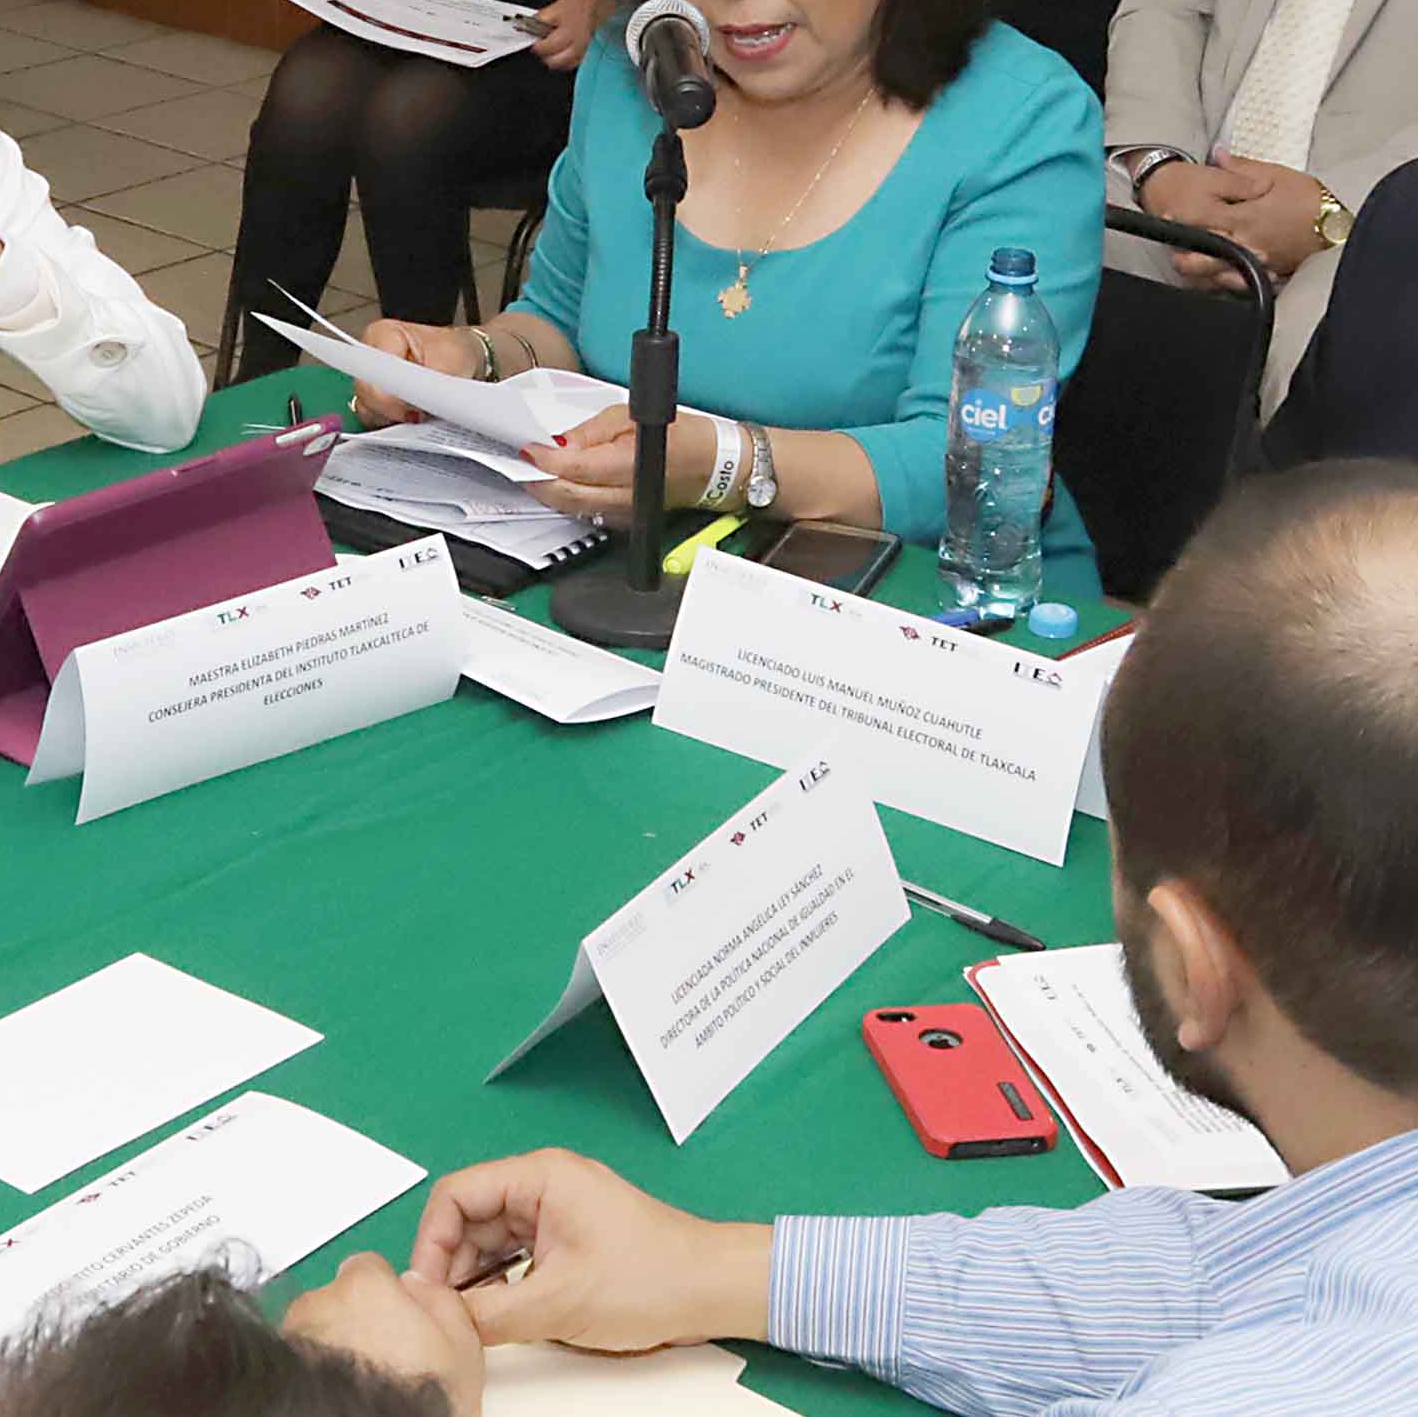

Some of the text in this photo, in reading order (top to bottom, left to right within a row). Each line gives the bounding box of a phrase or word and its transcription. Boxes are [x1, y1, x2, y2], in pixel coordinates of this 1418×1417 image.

[961, 398, 1009, 432] ciel
[217, 605, 250, 625] TLX
[810, 593, 844, 614] TLX
[189, 663, 240, 687] MAESTRA
[240, 644, 294, 671] ELIZABETH
[295, 631, 338, 653] PIEDRAS
[930, 635, 959, 653] TET
[148, 693, 209, 724] CONSEJERA
[210, 673, 274, 703] PRESIDENTA
[274, 668, 294, 683] DEL
[295, 647, 348, 674] INSTITUTO
[350, 626, 415, 656] TLAXCALTECA
[416, 621, 430, 636] DE
[263, 677, 324, 706] ELECCIONES
[737, 648, 983, 741] LICENCIADO LUIS MANUEL MUÑOZ CUAHUTLE
[680, 653, 1037, 782] MAGISTRADO PRESIDENTE DEL TRIBUNAL ELECTORAL DE TLAXCALA
[102, 1221, 171, 1264] CERVANTES
[158, 1214, 221, 1255] GOBIERNO
